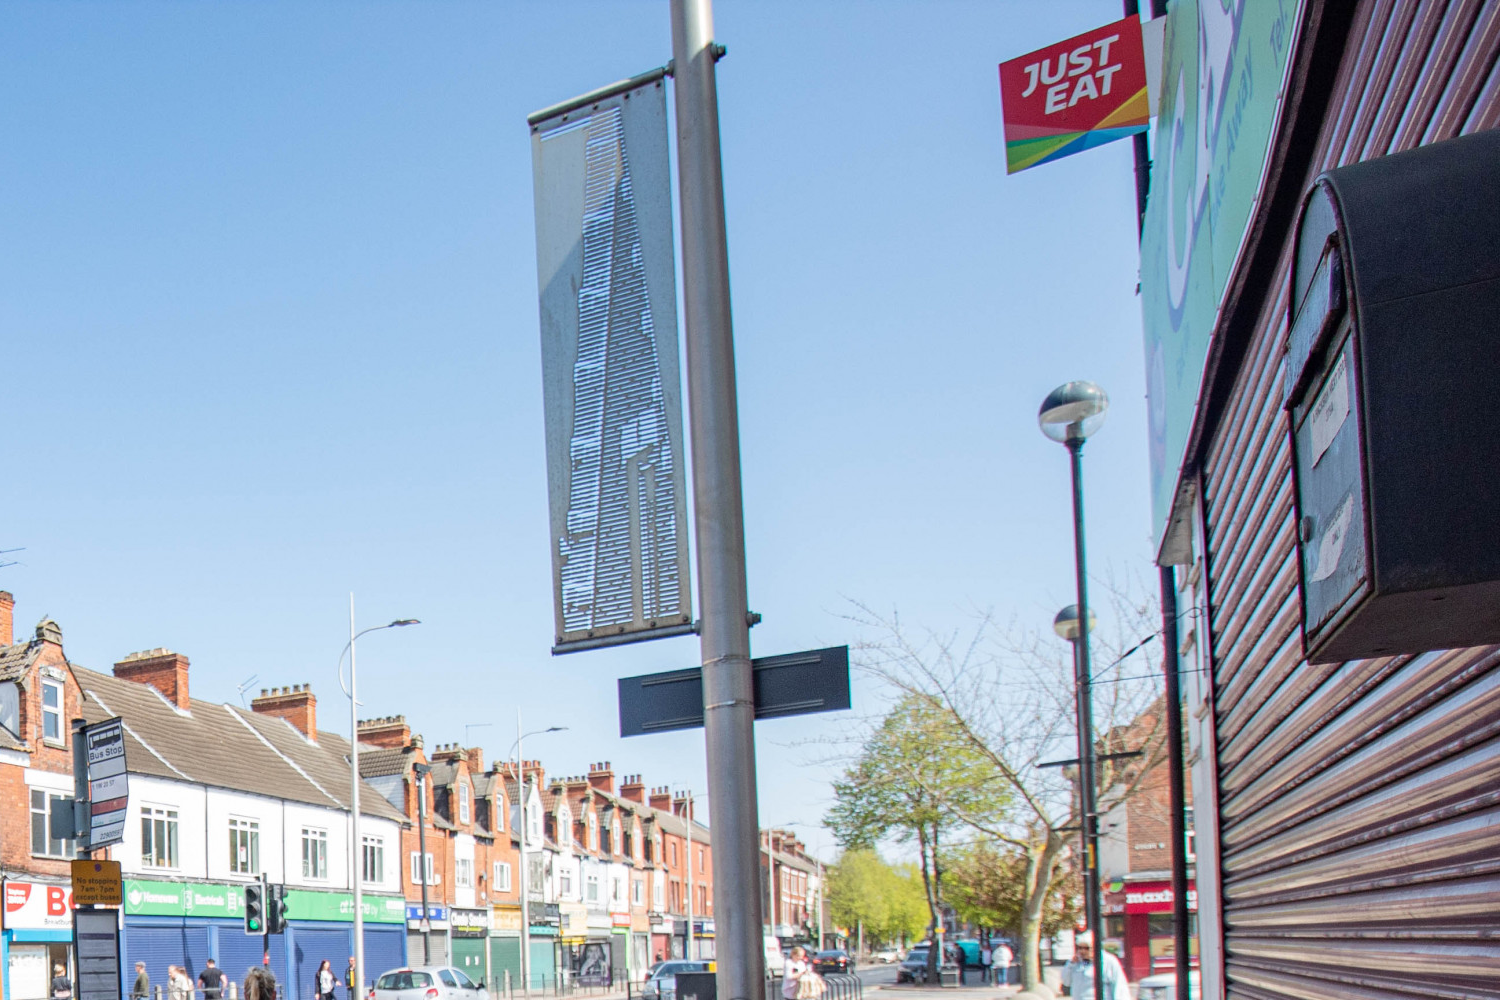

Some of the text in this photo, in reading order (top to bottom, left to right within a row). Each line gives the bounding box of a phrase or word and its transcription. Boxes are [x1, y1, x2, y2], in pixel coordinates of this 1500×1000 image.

[1021, 34, 1120, 98] JUST
[1044, 63, 1122, 115] EAT
[1226, 36, 1254, 172] Away
[89, 745, 123, 761] Bus Stop
[88, 878, 118, 886] stopping
